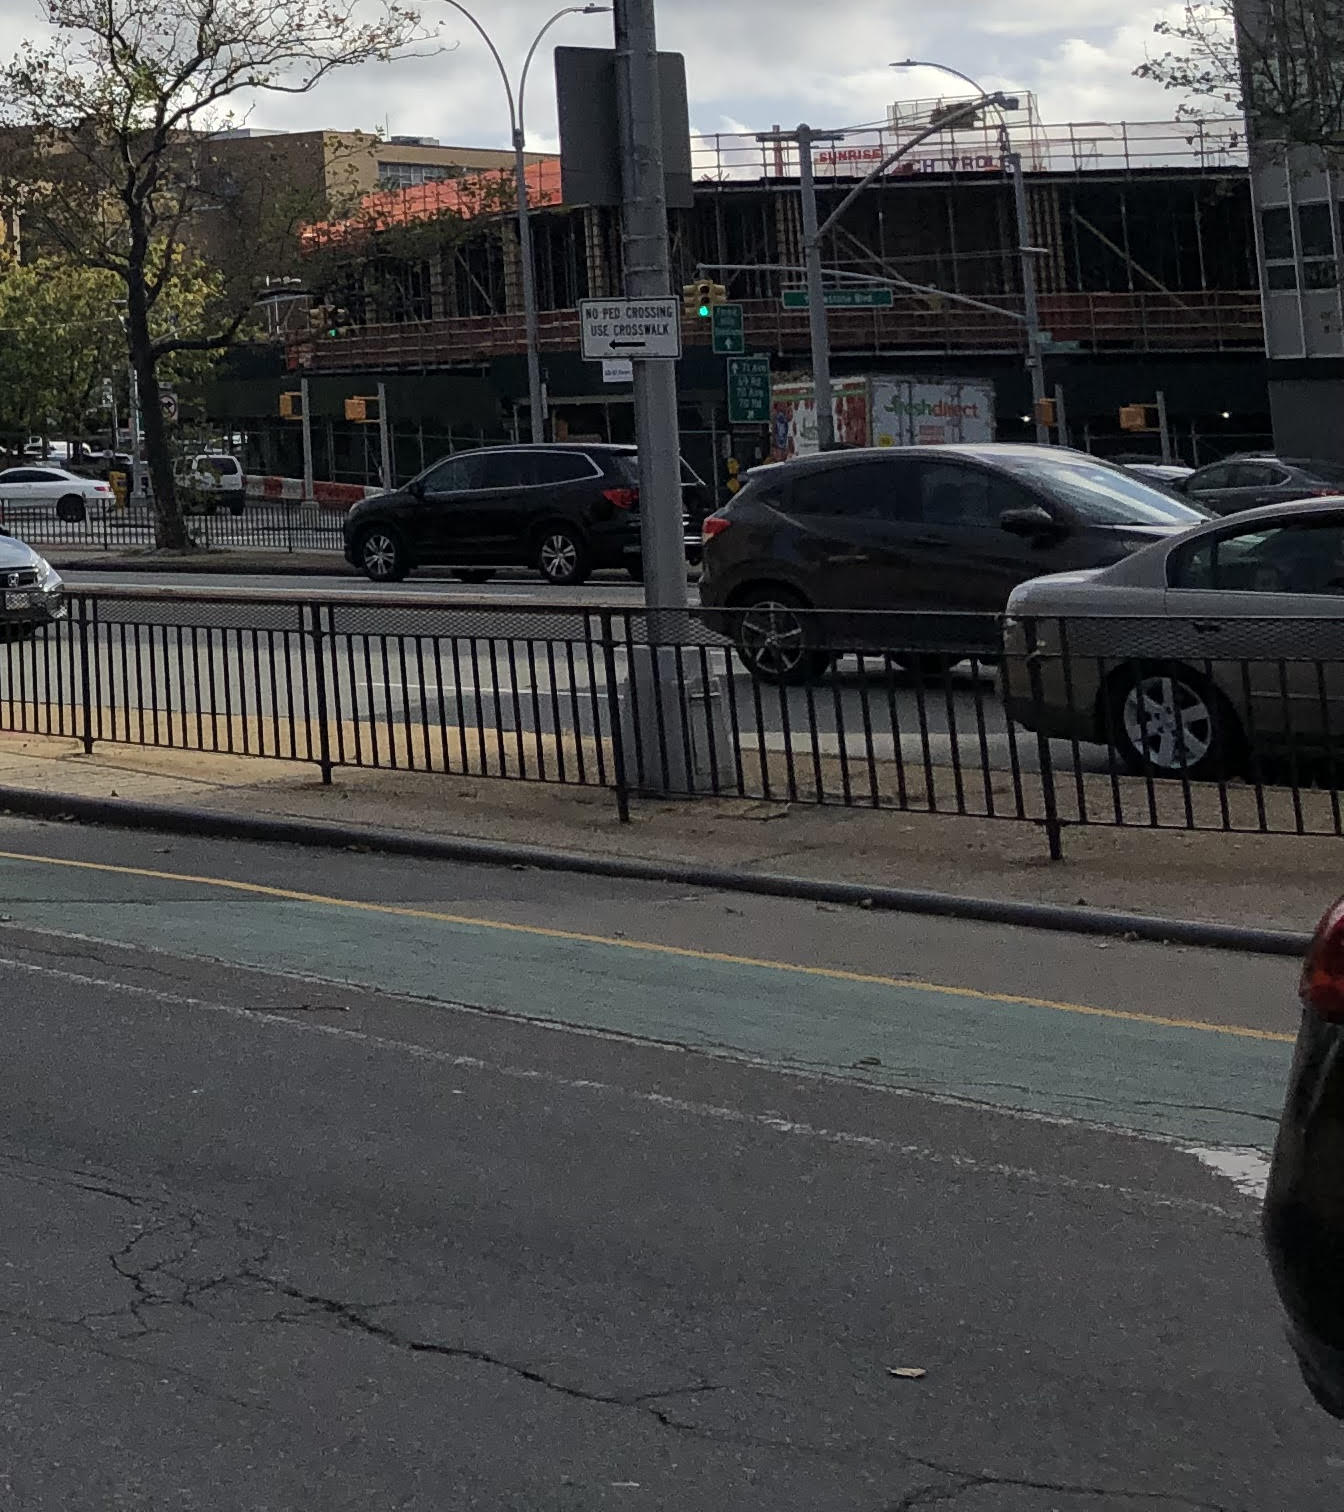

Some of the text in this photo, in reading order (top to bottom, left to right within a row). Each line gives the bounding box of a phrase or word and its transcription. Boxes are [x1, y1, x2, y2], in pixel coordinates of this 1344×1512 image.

[819, 148, 882, 164] SUNRISE
[585, 306, 673, 320] NO PED CROSSING
[591, 323, 669, 337] USE CROSSWALK
